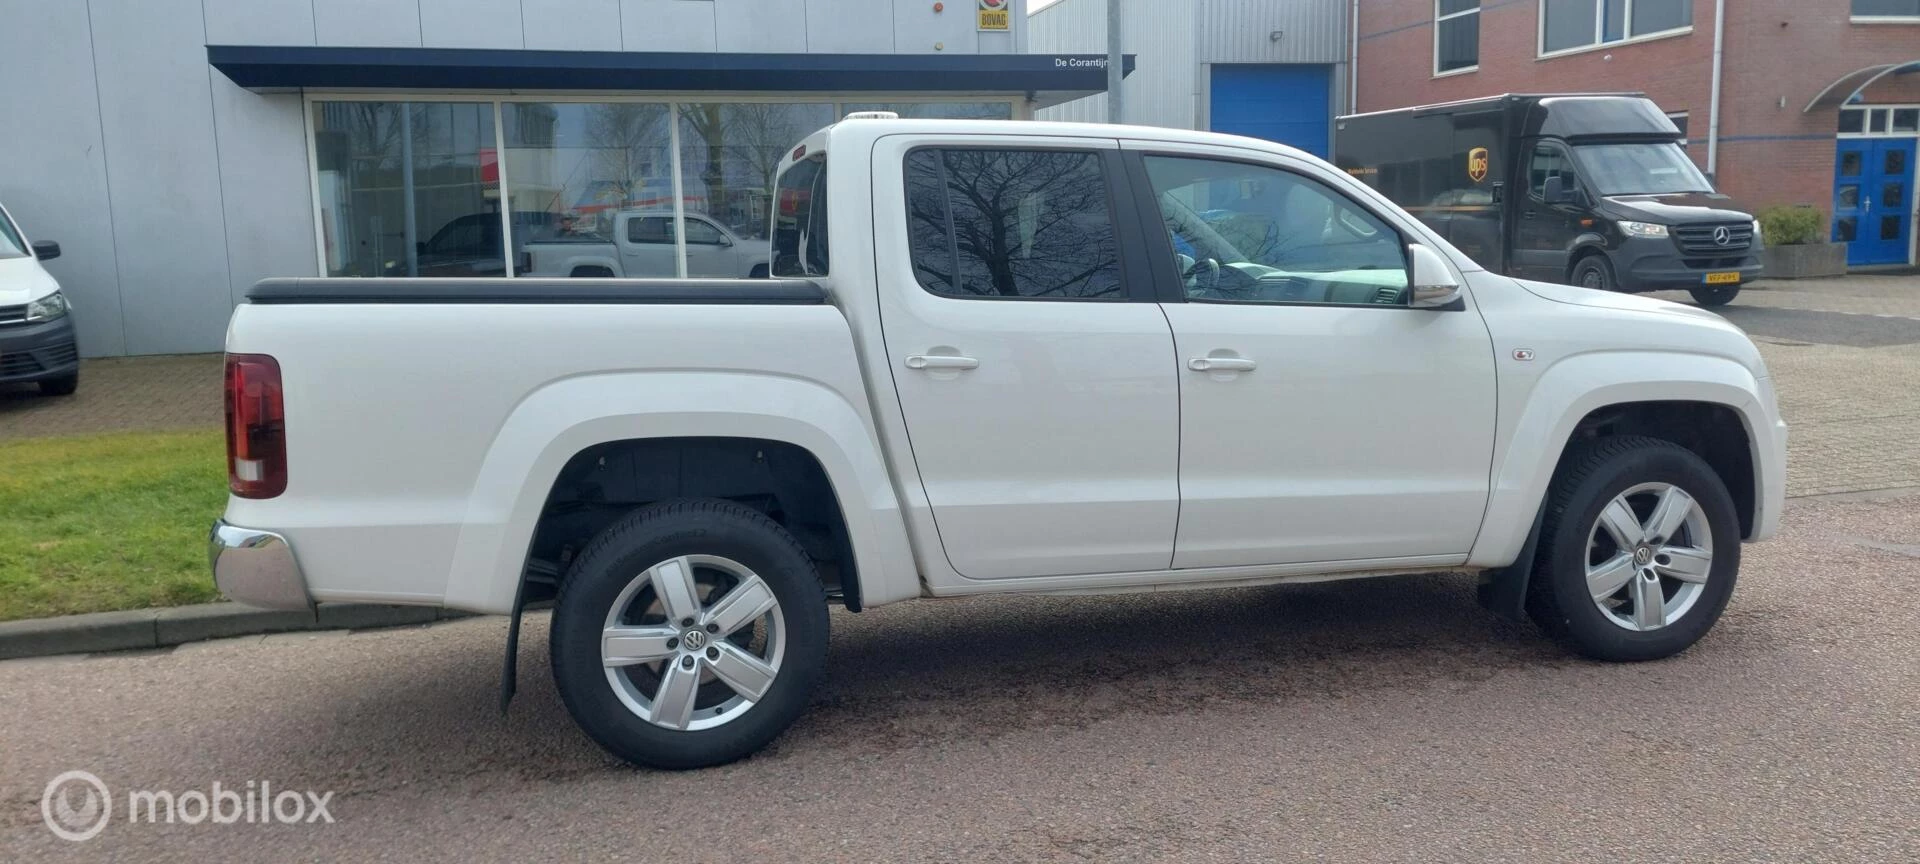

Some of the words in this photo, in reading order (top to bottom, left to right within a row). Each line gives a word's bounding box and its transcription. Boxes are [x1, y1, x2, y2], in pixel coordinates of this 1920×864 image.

[982, 13, 1006, 26] BOVAG
[1055, 58, 1067, 67] De
[1471, 158, 1487, 177] ups
